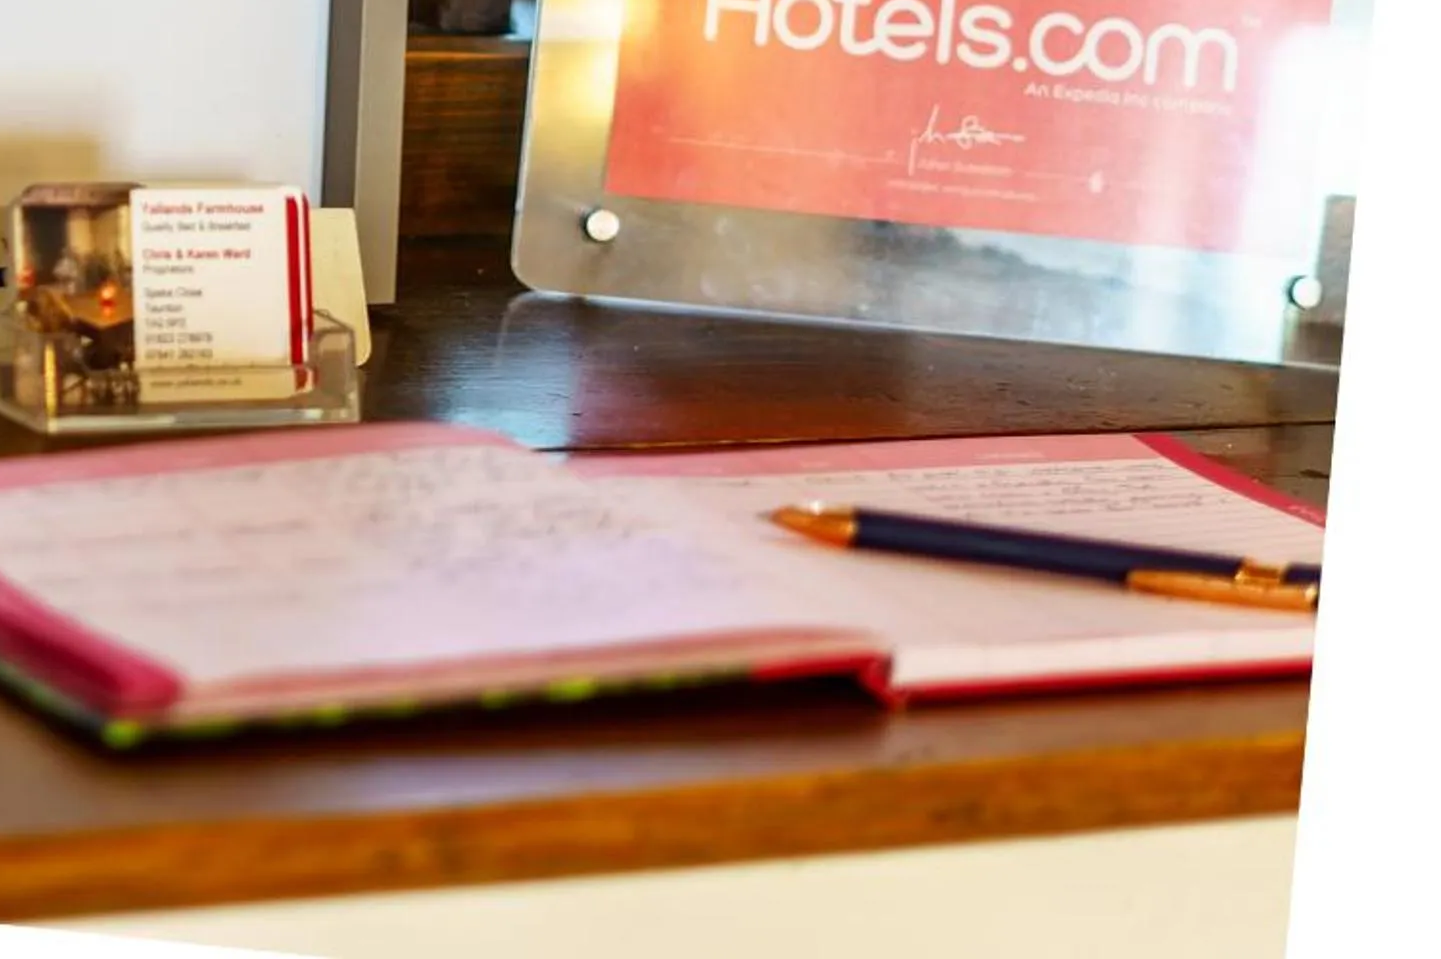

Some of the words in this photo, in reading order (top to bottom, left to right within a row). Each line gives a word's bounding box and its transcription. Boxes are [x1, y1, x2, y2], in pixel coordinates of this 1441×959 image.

[1023, 81, 1050, 98] An
[1052, 83, 1121, 106] Expedia
[142, 203, 192, 215] Yallands
[197, 202, 264, 215] Farmhouse
[187, 248, 220, 259] Karen
